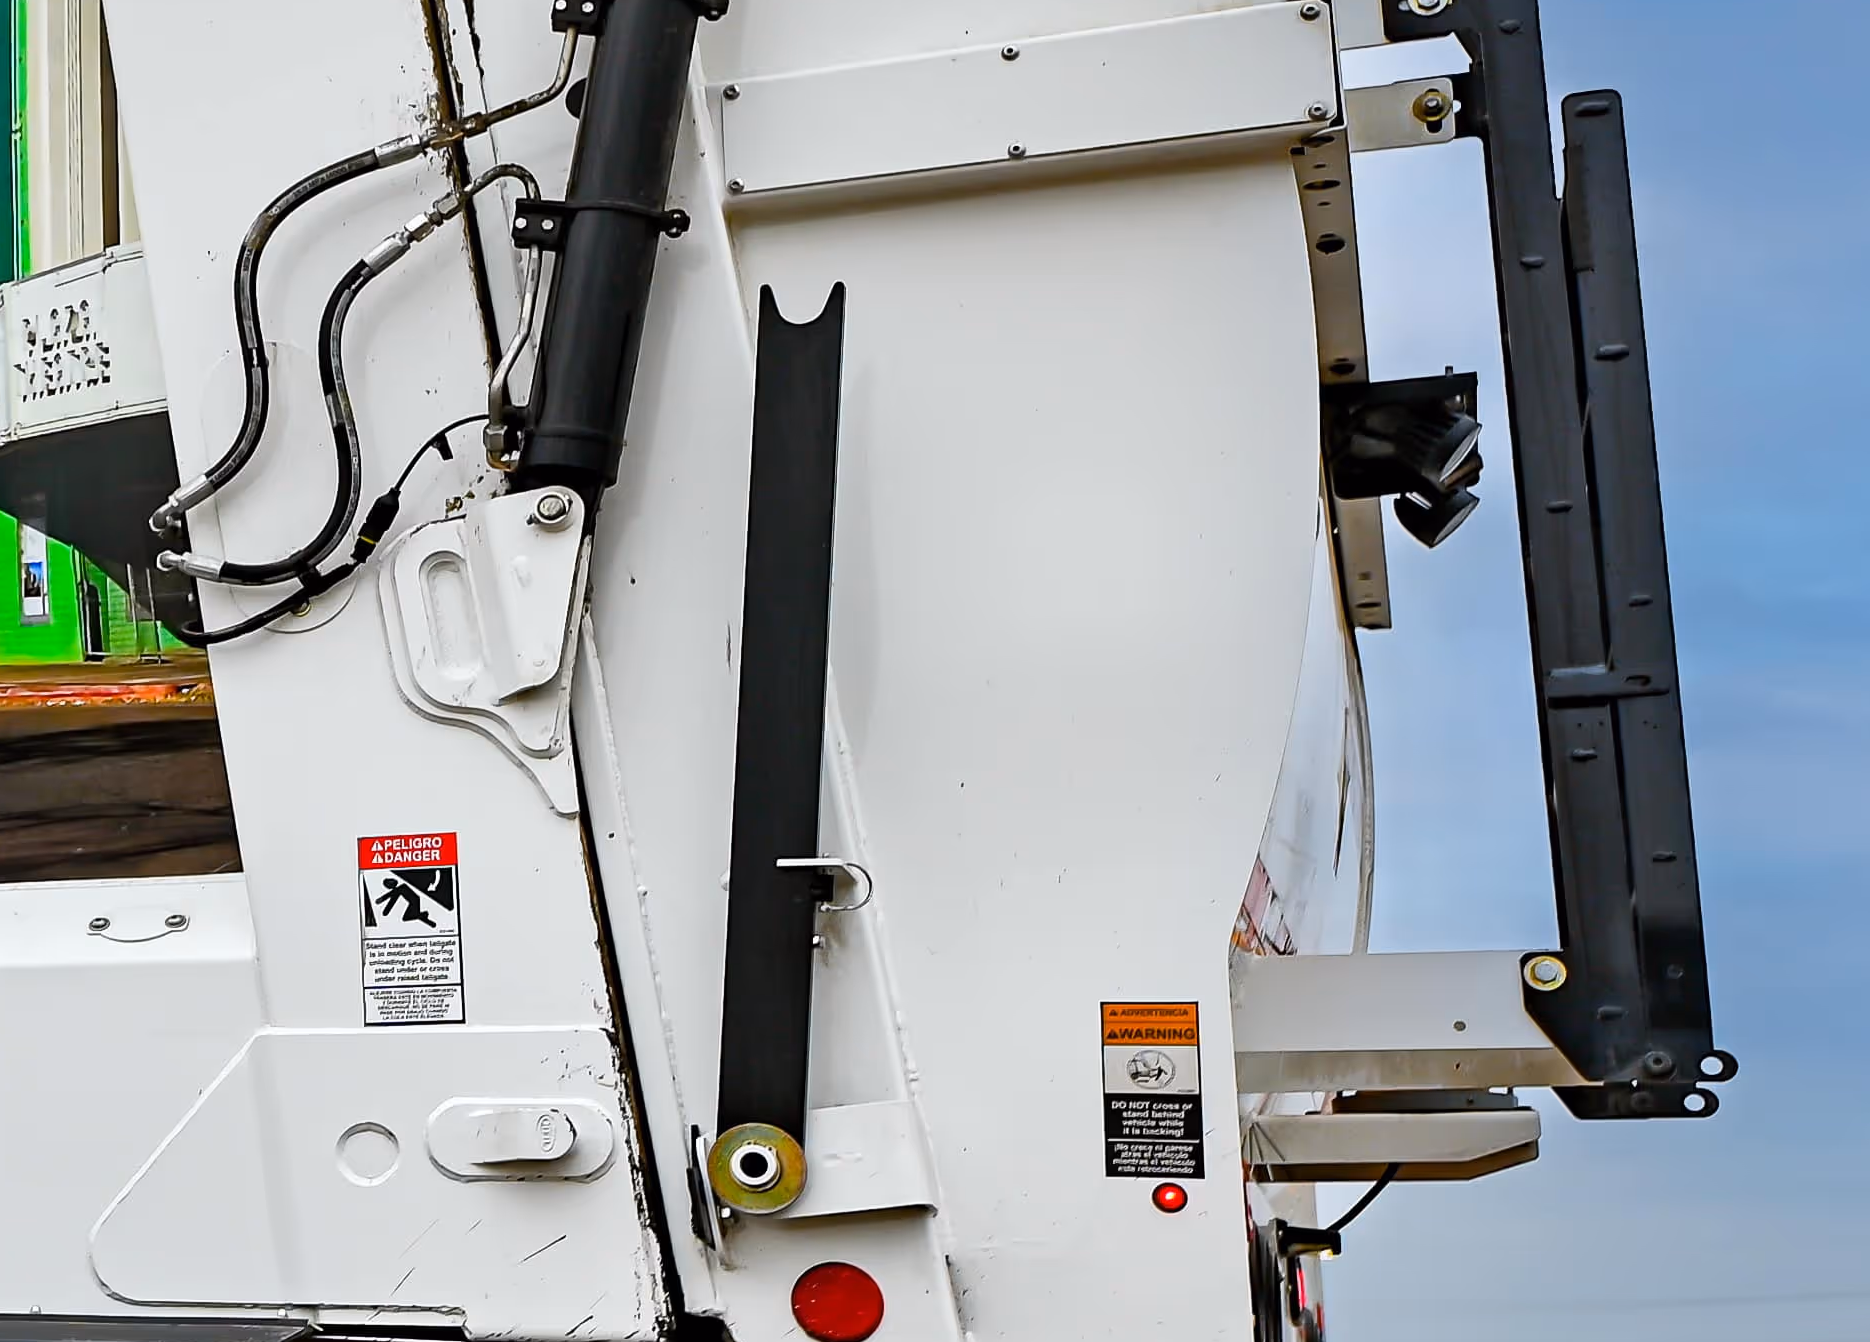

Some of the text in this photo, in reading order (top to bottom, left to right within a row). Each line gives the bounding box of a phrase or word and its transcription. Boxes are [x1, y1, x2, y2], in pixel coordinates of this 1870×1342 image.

[384, 837, 442, 851] PELIGRO
[384, 849, 440, 863] DANGER
[1120, 1027, 1195, 1040] WARNING
[1112, 1101, 1126, 1109] DO
[1129, 1101, 1150, 1109] NOT
